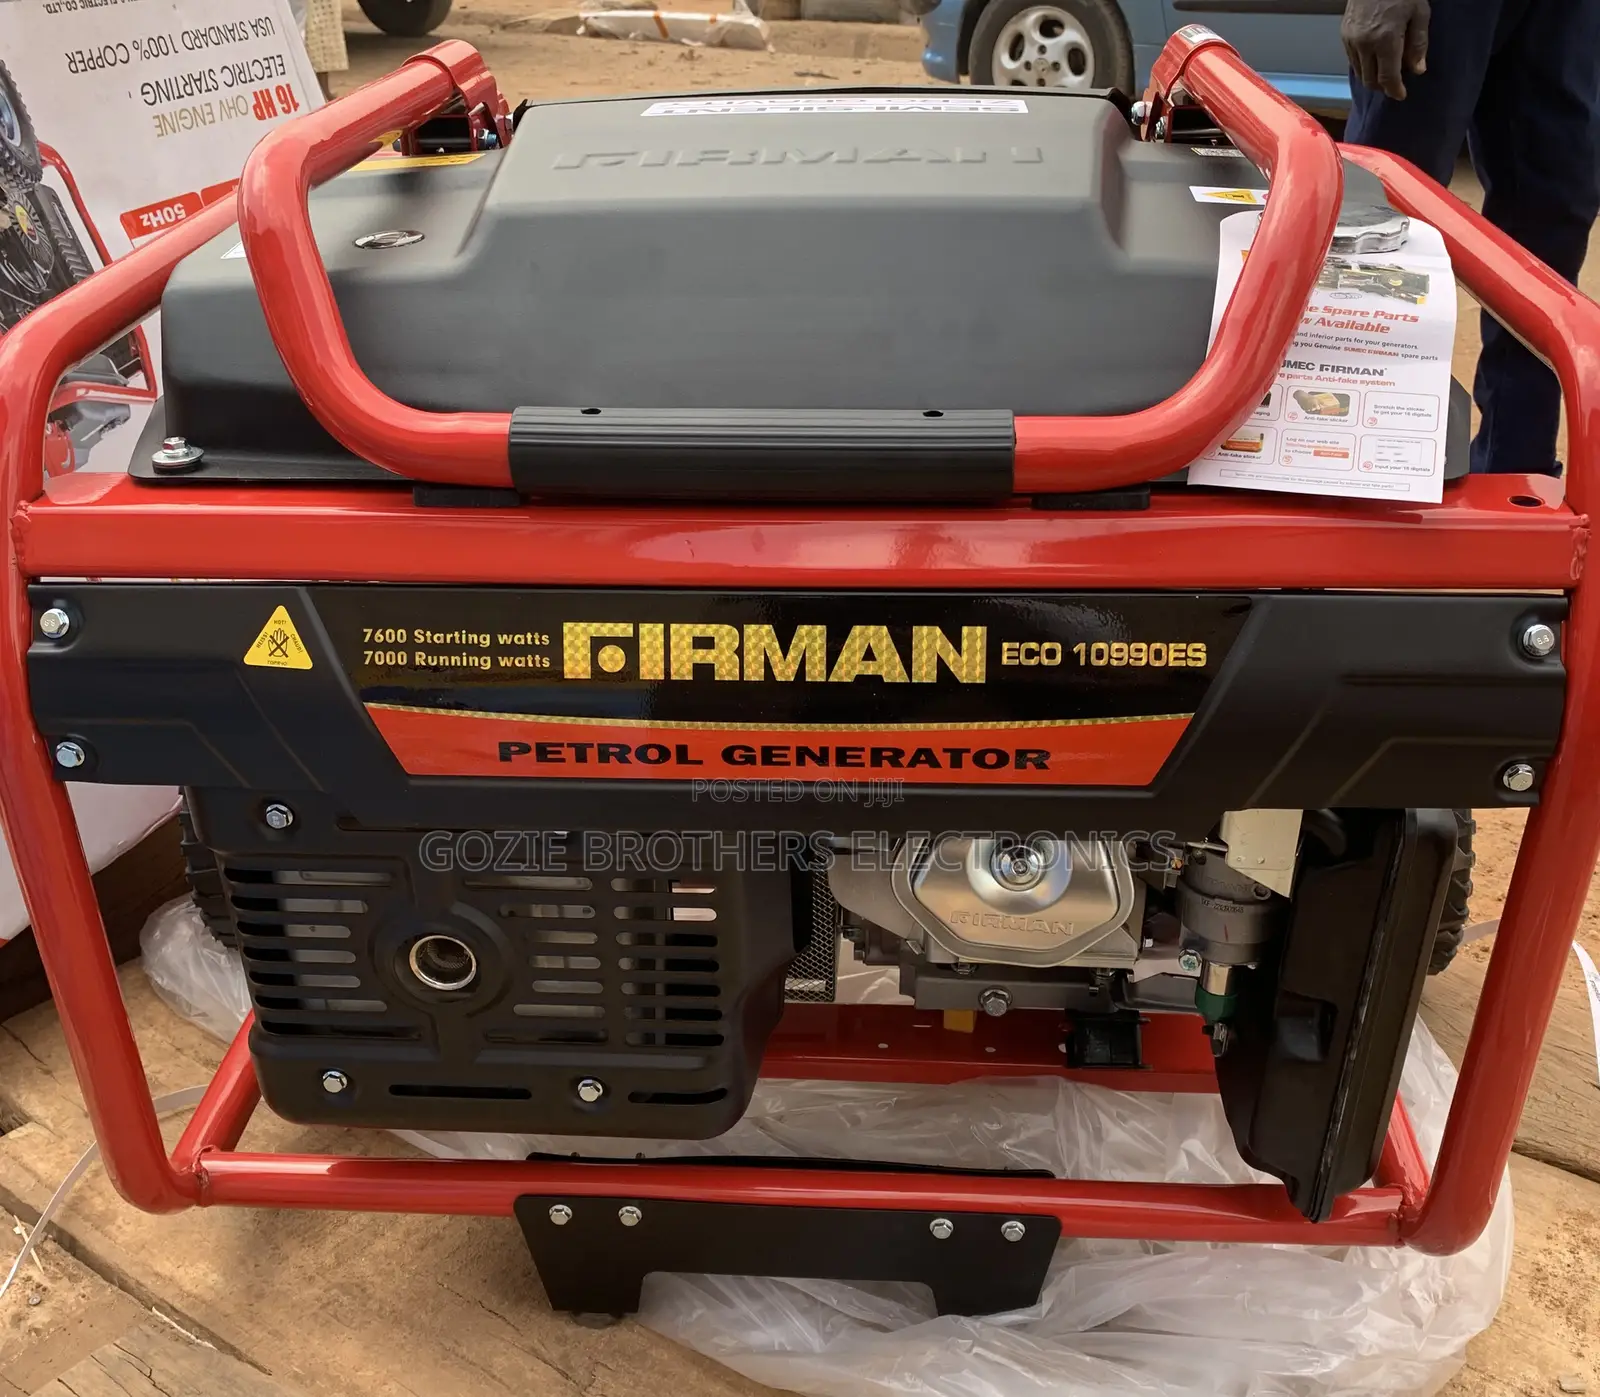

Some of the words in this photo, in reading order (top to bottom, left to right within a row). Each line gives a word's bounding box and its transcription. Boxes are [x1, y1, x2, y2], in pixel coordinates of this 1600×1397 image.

[181, 21, 249, 51] STANDARD
[248, 16, 276, 38] USA
[64, 42, 130, 74] COPPER
[132, 33, 179, 61] 100%
[220, 54, 286, 88] ELECTRIC
[140, 68, 219, 106] STARTING
[275, 83, 300, 114] 16
[219, 94, 249, 121] OHV
[252, 88, 279, 121] HP
[152, 102, 216, 138] ENGINE
[139, 202, 187, 228] 50Hz
[1314, 317, 1391, 333] Available
[1321, 305, 1370, 318] Spare
[1373, 310, 1420, 323] Parts
[1310, 332, 1334, 340] inferior
[1314, 342, 1341, 351] Genuine
[1344, 346, 1367, 354] SUMEC
[1368, 349, 1399, 357] FIRMAN
[1287, 373, 1313, 381] parts
[1315, 375, 1358, 385] Anti-fake
[1360, 379, 1396, 387] system
[363, 628, 407, 643] 7600
[414, 628, 491, 648] Starting
[497, 631, 551, 646] watts
[364, 650, 408, 666] 7000
[415, 651, 492, 671] Running
[498, 653, 551, 668] watts
[562, 622, 988, 684] FIRMAN
[1001, 641, 1063, 666] ECO
[1073, 641, 1208, 668] 10990ES
[498, 741, 704, 766] PETROL
[721, 743, 1051, 771] GENERATOR
[949, 910, 1076, 937] FIRMAN
